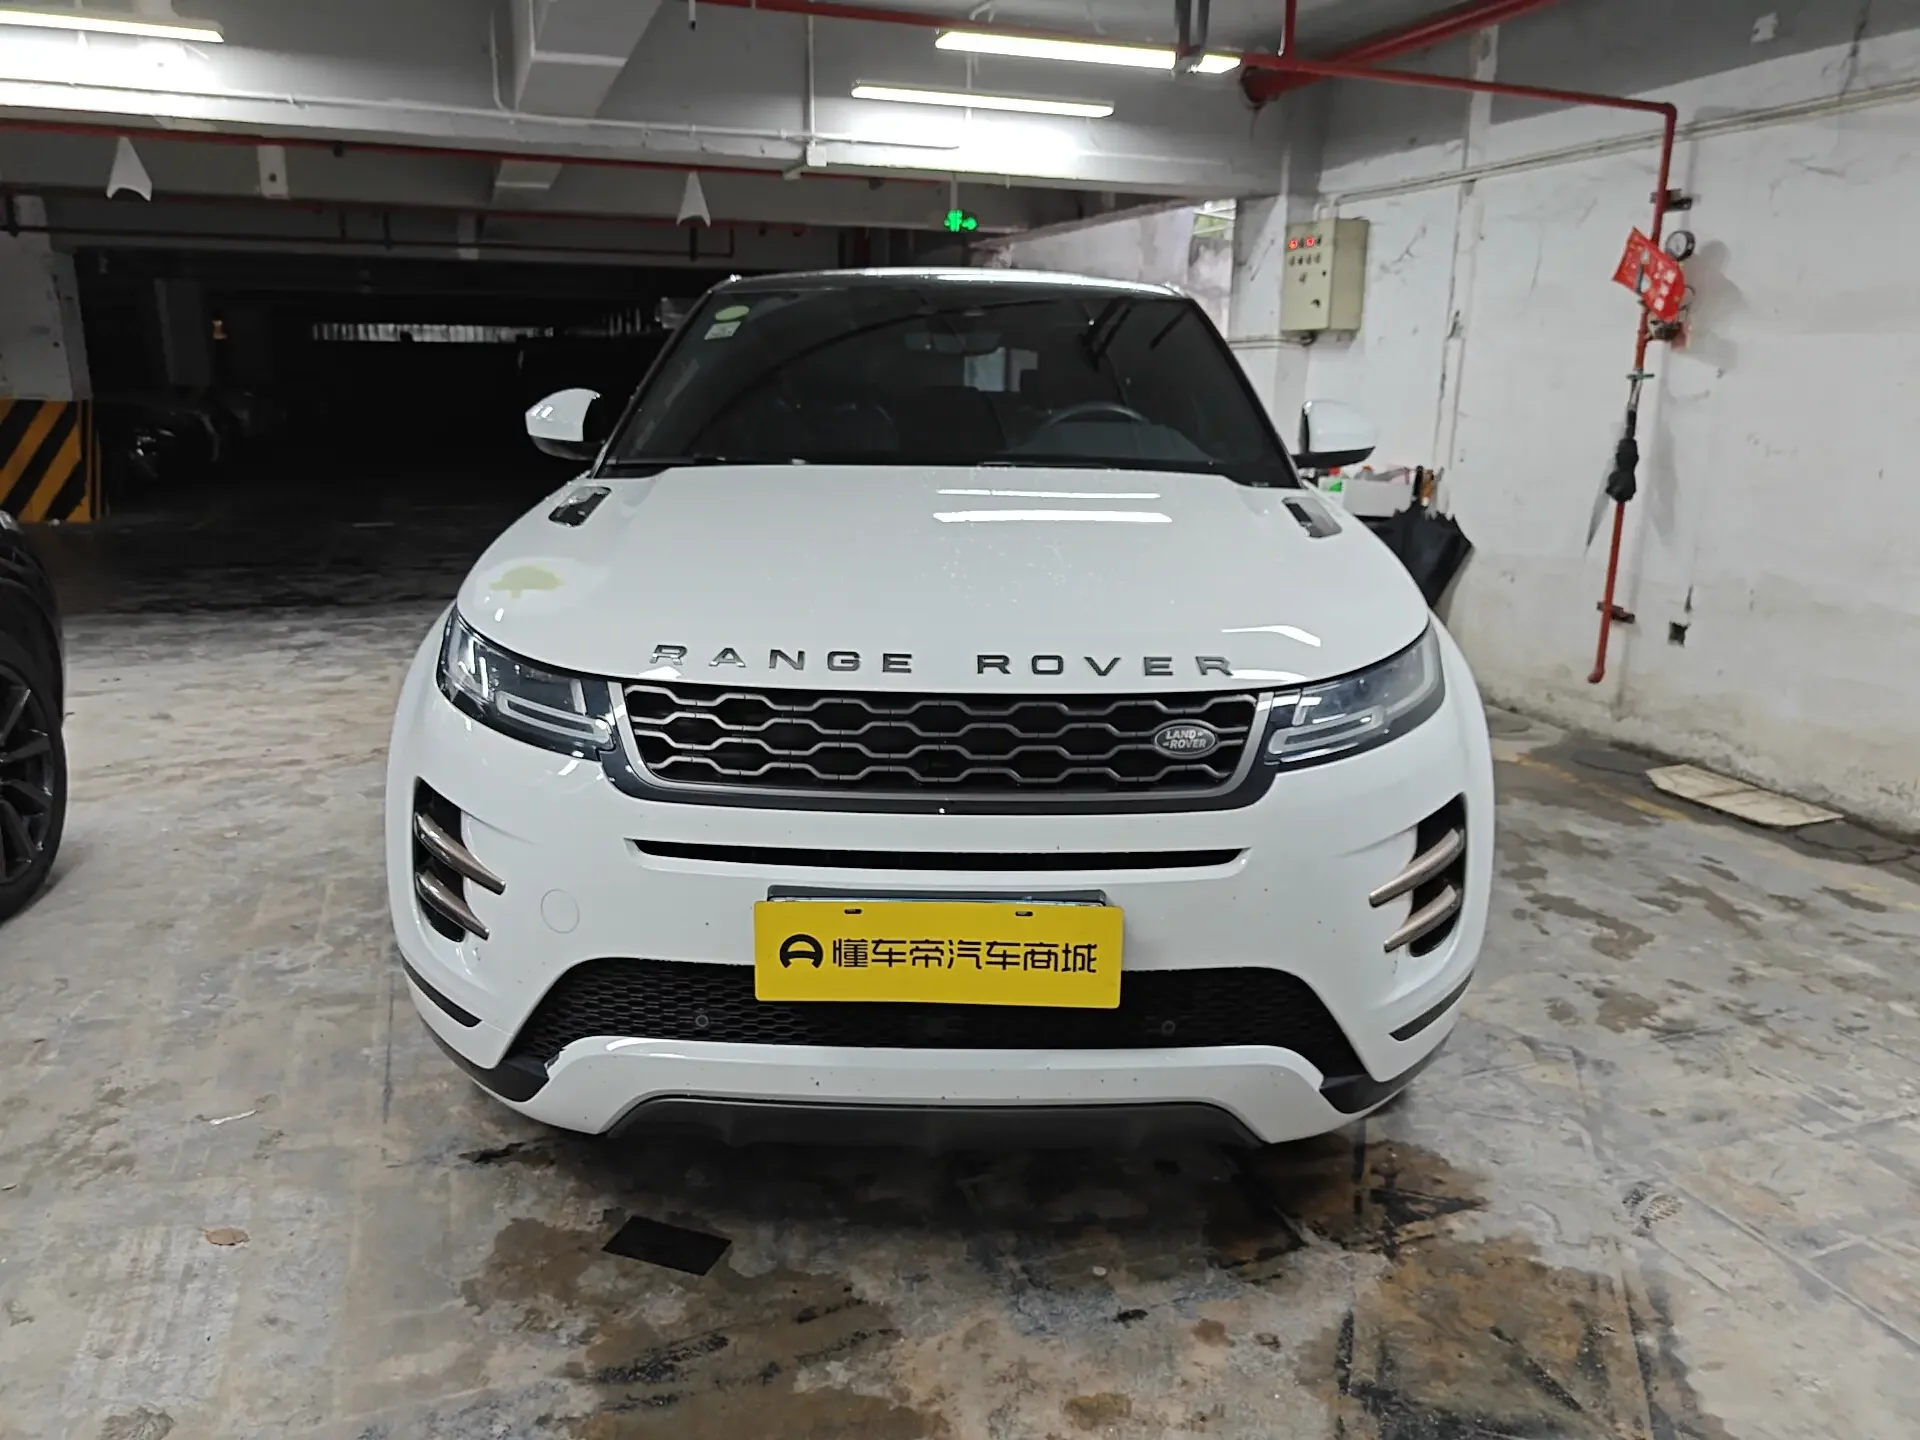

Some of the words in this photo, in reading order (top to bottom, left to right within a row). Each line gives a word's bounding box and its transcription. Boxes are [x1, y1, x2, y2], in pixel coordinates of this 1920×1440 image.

[649, 644, 913, 673] RANGE
[977, 654, 1234, 677] ROVER
[1166, 730, 1197, 740] LAND
[1169, 739, 1207, 749] ROVER
[832, 937, 1098, 974] 懂车帝汽车商城
